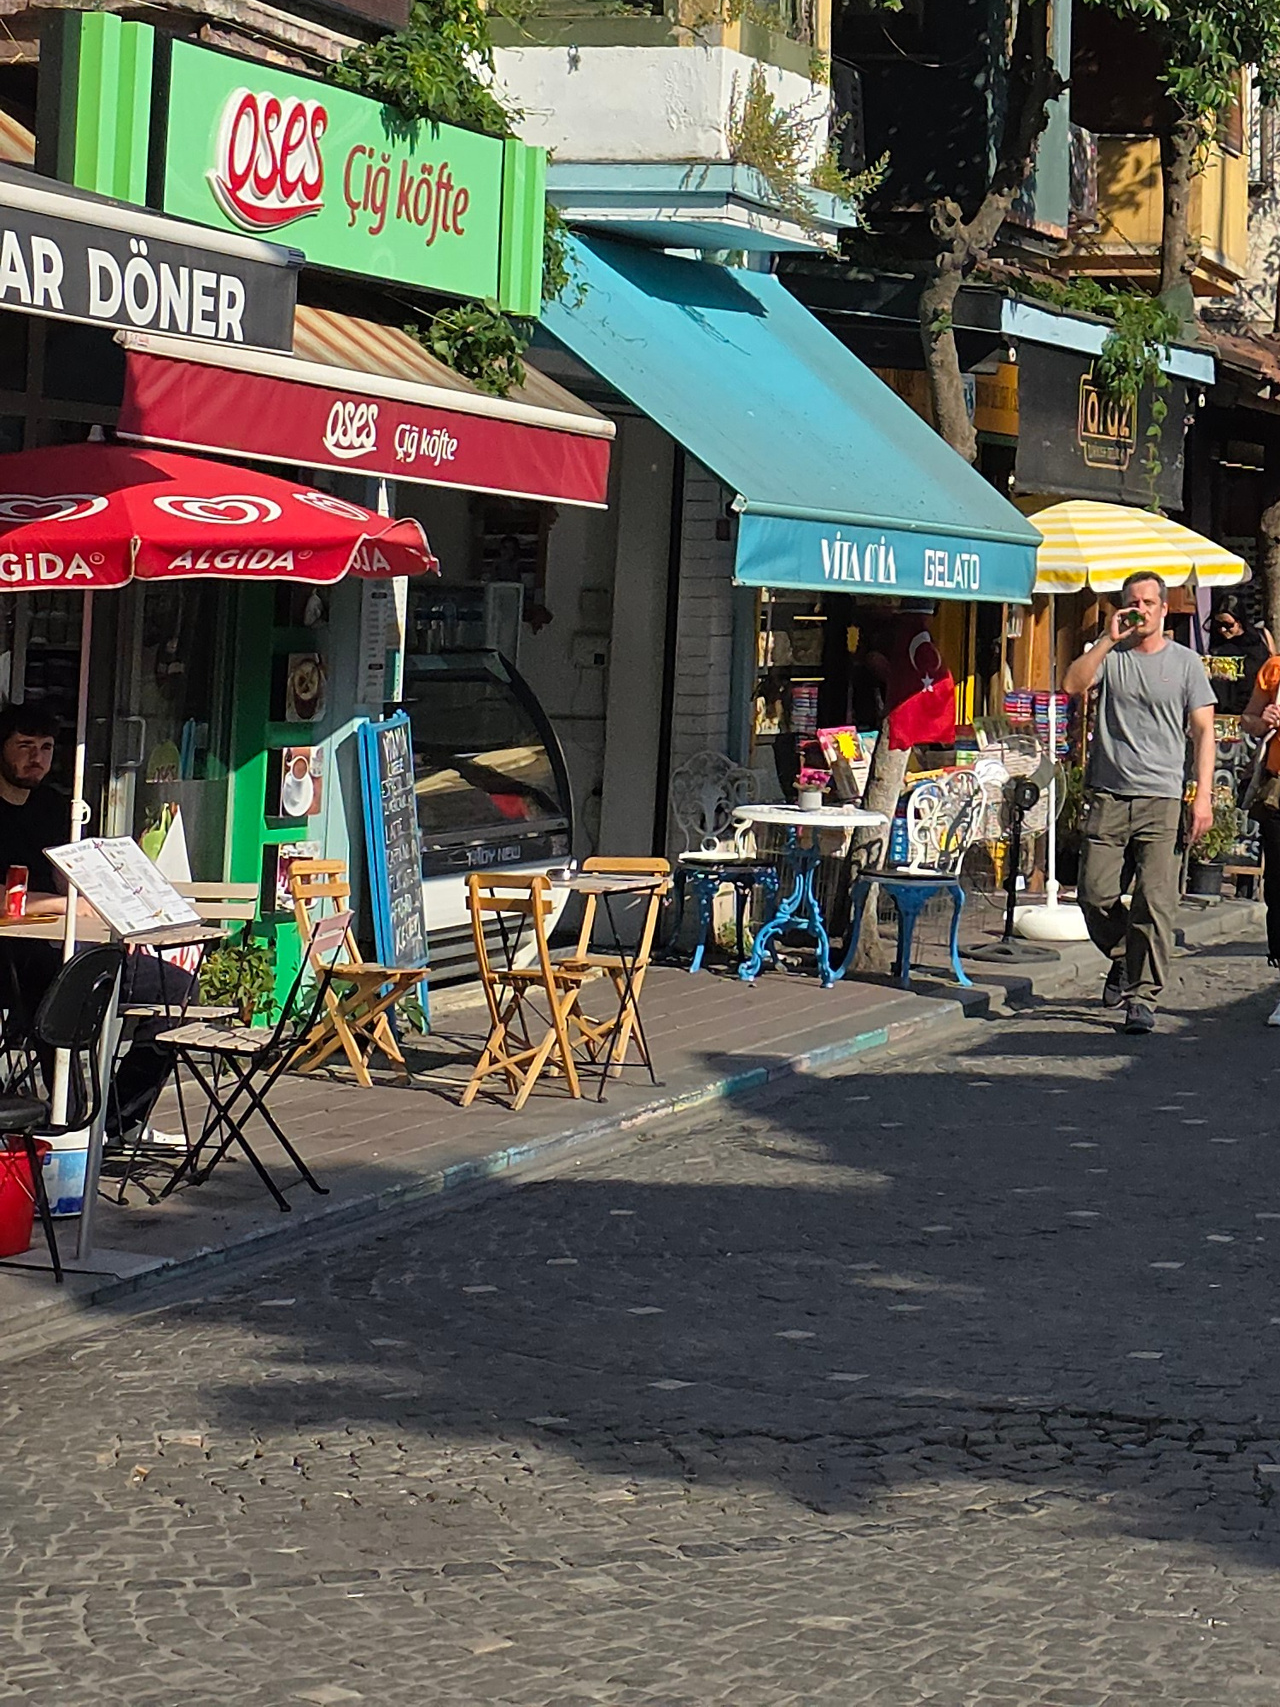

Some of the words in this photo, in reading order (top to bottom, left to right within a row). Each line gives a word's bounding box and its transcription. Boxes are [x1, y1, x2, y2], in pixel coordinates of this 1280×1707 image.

[222, 91, 328, 224] oses
[344, 144, 391, 235] Çiğ
[396, 160, 469, 246] köfte
[87, 238, 246, 341] DÖNER
[323, 400, 379, 458] oses
[394, 423, 419, 463] Çiğ
[420, 427, 458, 466] köfte
[923, 548, 980, 590] GELATO
